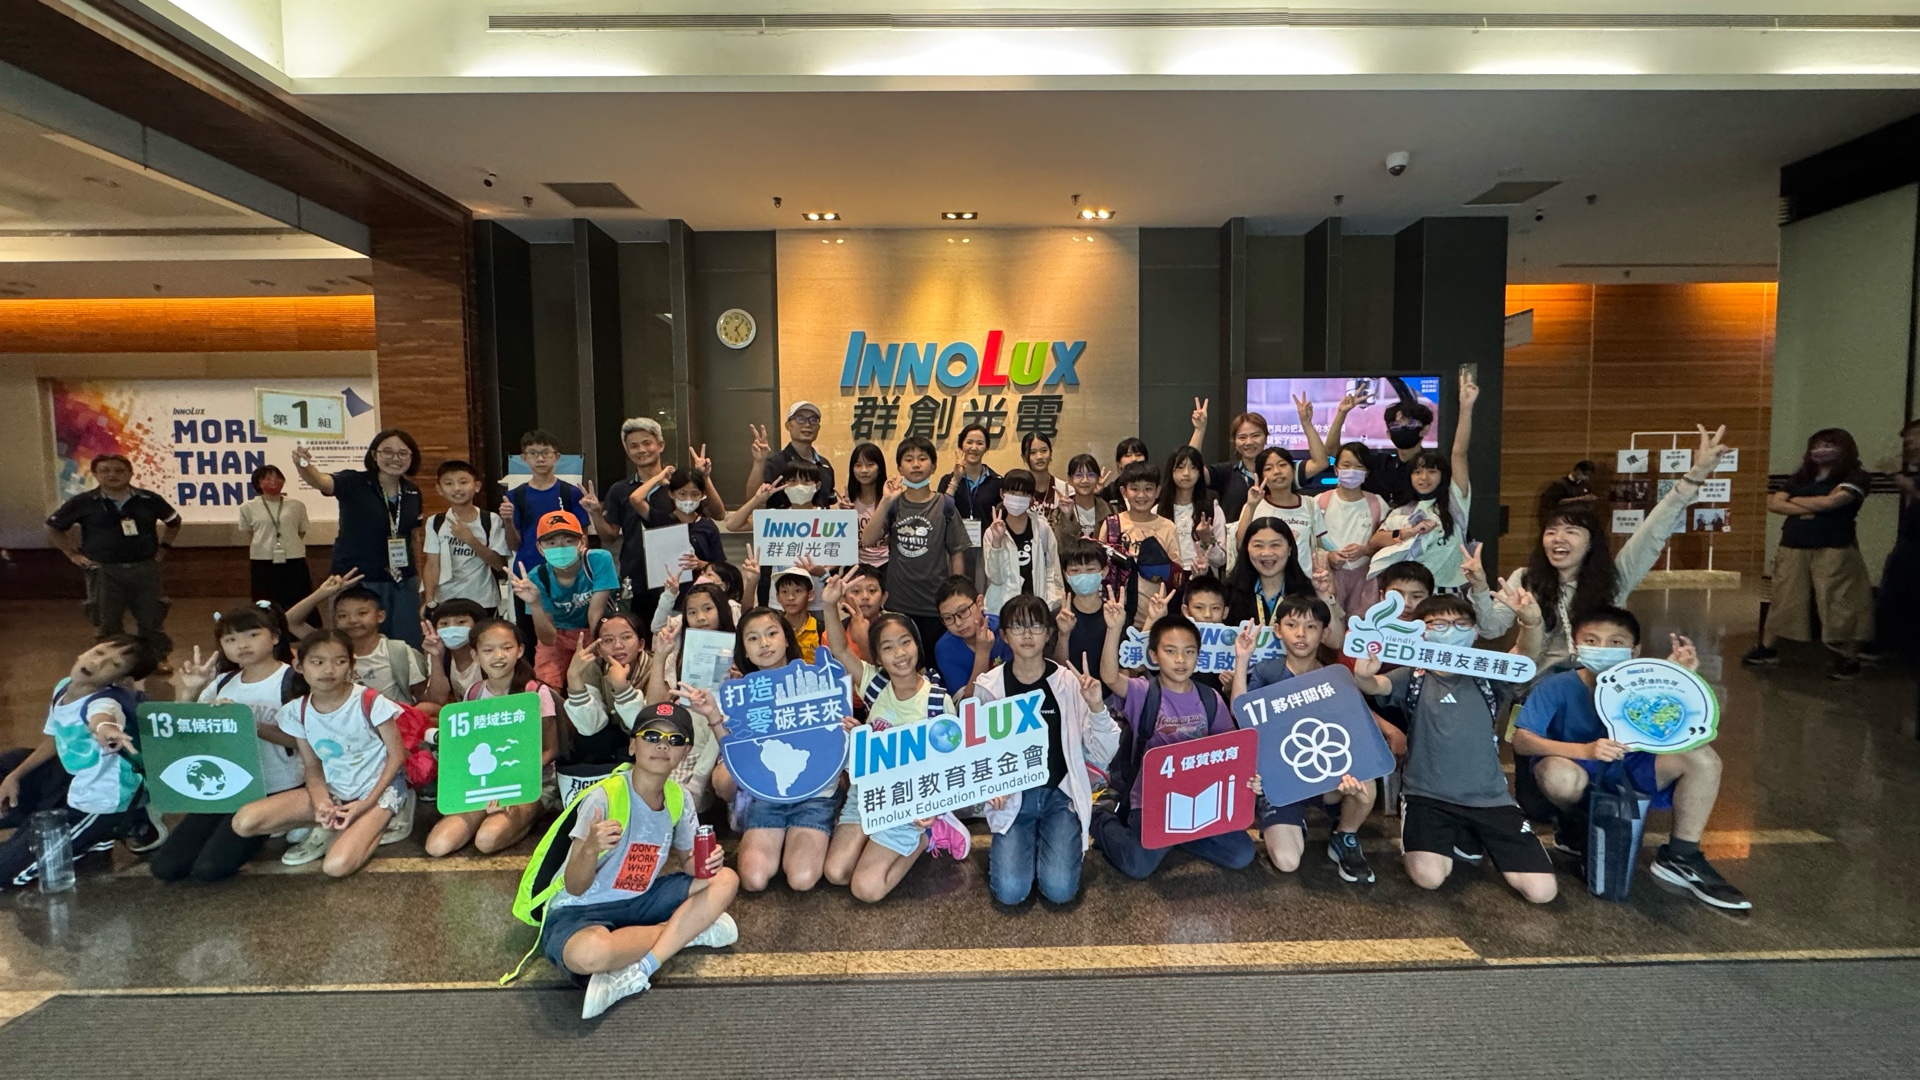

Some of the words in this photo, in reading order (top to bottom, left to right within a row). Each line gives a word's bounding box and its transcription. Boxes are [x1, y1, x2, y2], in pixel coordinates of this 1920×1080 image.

[841, 330, 1087, 388] INNOLUX
[851, 395, 1064, 440] 群創光電
[174, 450, 266, 475] THAN
[178, 482, 287, 506] PAN
[766, 541, 841, 558] 群創光電
[1417, 647, 1529, 678] 環境友善種子
[724, 676, 775, 708] 打造
[1243, 698, 1268, 727] 17
[1271, 682, 1336, 714] 夥伴關係
[147, 713, 174, 738] 13
[176, 718, 238, 733] 氣候行動
[448, 712, 470, 738] 15
[473, 709, 526, 730] 陸域生命
[746, 698, 844, 734] 零碳未來
[1159, 755, 1176, 778] 4
[1180, 746, 1240, 772] 優質教育
[863, 744, 1044, 814] 群創教育基金會
[866, 806, 912, 829] Innolux
[916, 789, 976, 815] Education
[980, 770, 1046, 797] Foundation
[628, 853, 656, 863] WORK
[625, 873, 646, 882] ASS
